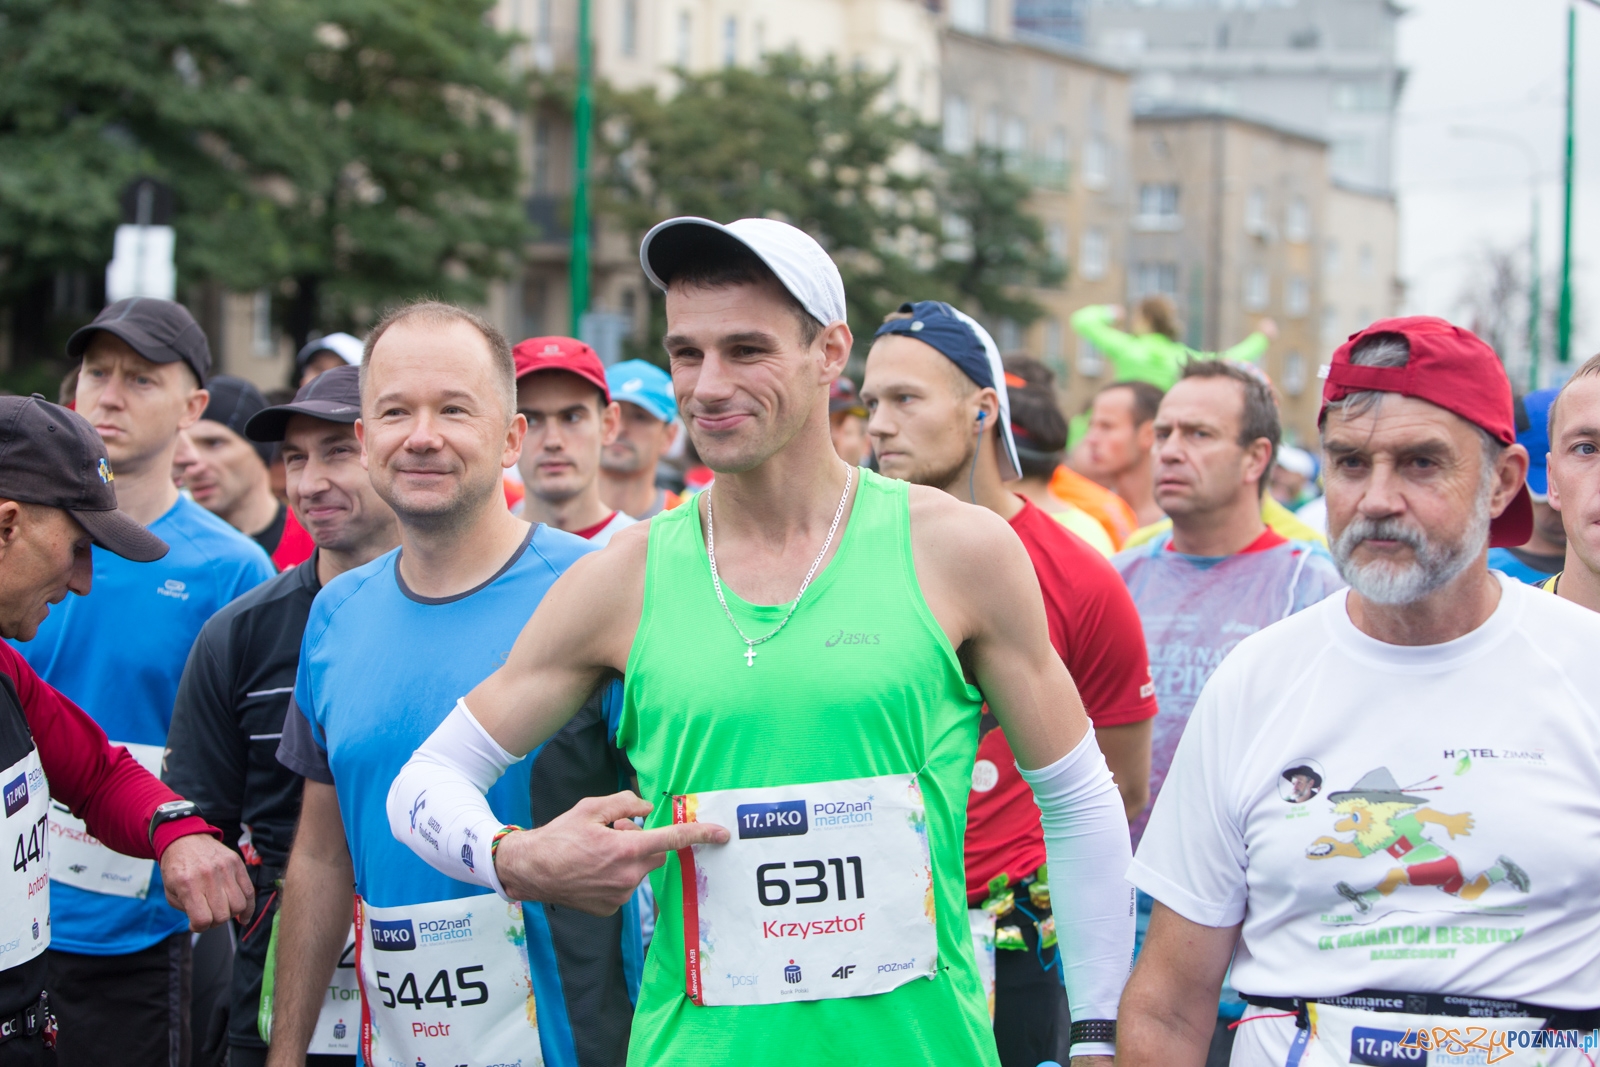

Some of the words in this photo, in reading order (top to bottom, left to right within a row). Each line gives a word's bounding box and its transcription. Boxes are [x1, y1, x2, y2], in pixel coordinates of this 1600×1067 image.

[815, 811, 873, 827] maraton
[13, 812, 49, 872] 447
[756, 855, 865, 907] 6311
[421, 928, 473, 943] maraton
[763, 913, 866, 940] Krzysztof
[1337, 925, 1431, 949] MARATON
[831, 964, 856, 979] 4F
[376, 964, 489, 1010] 5445
[411, 1021, 451, 1038] Piotr
